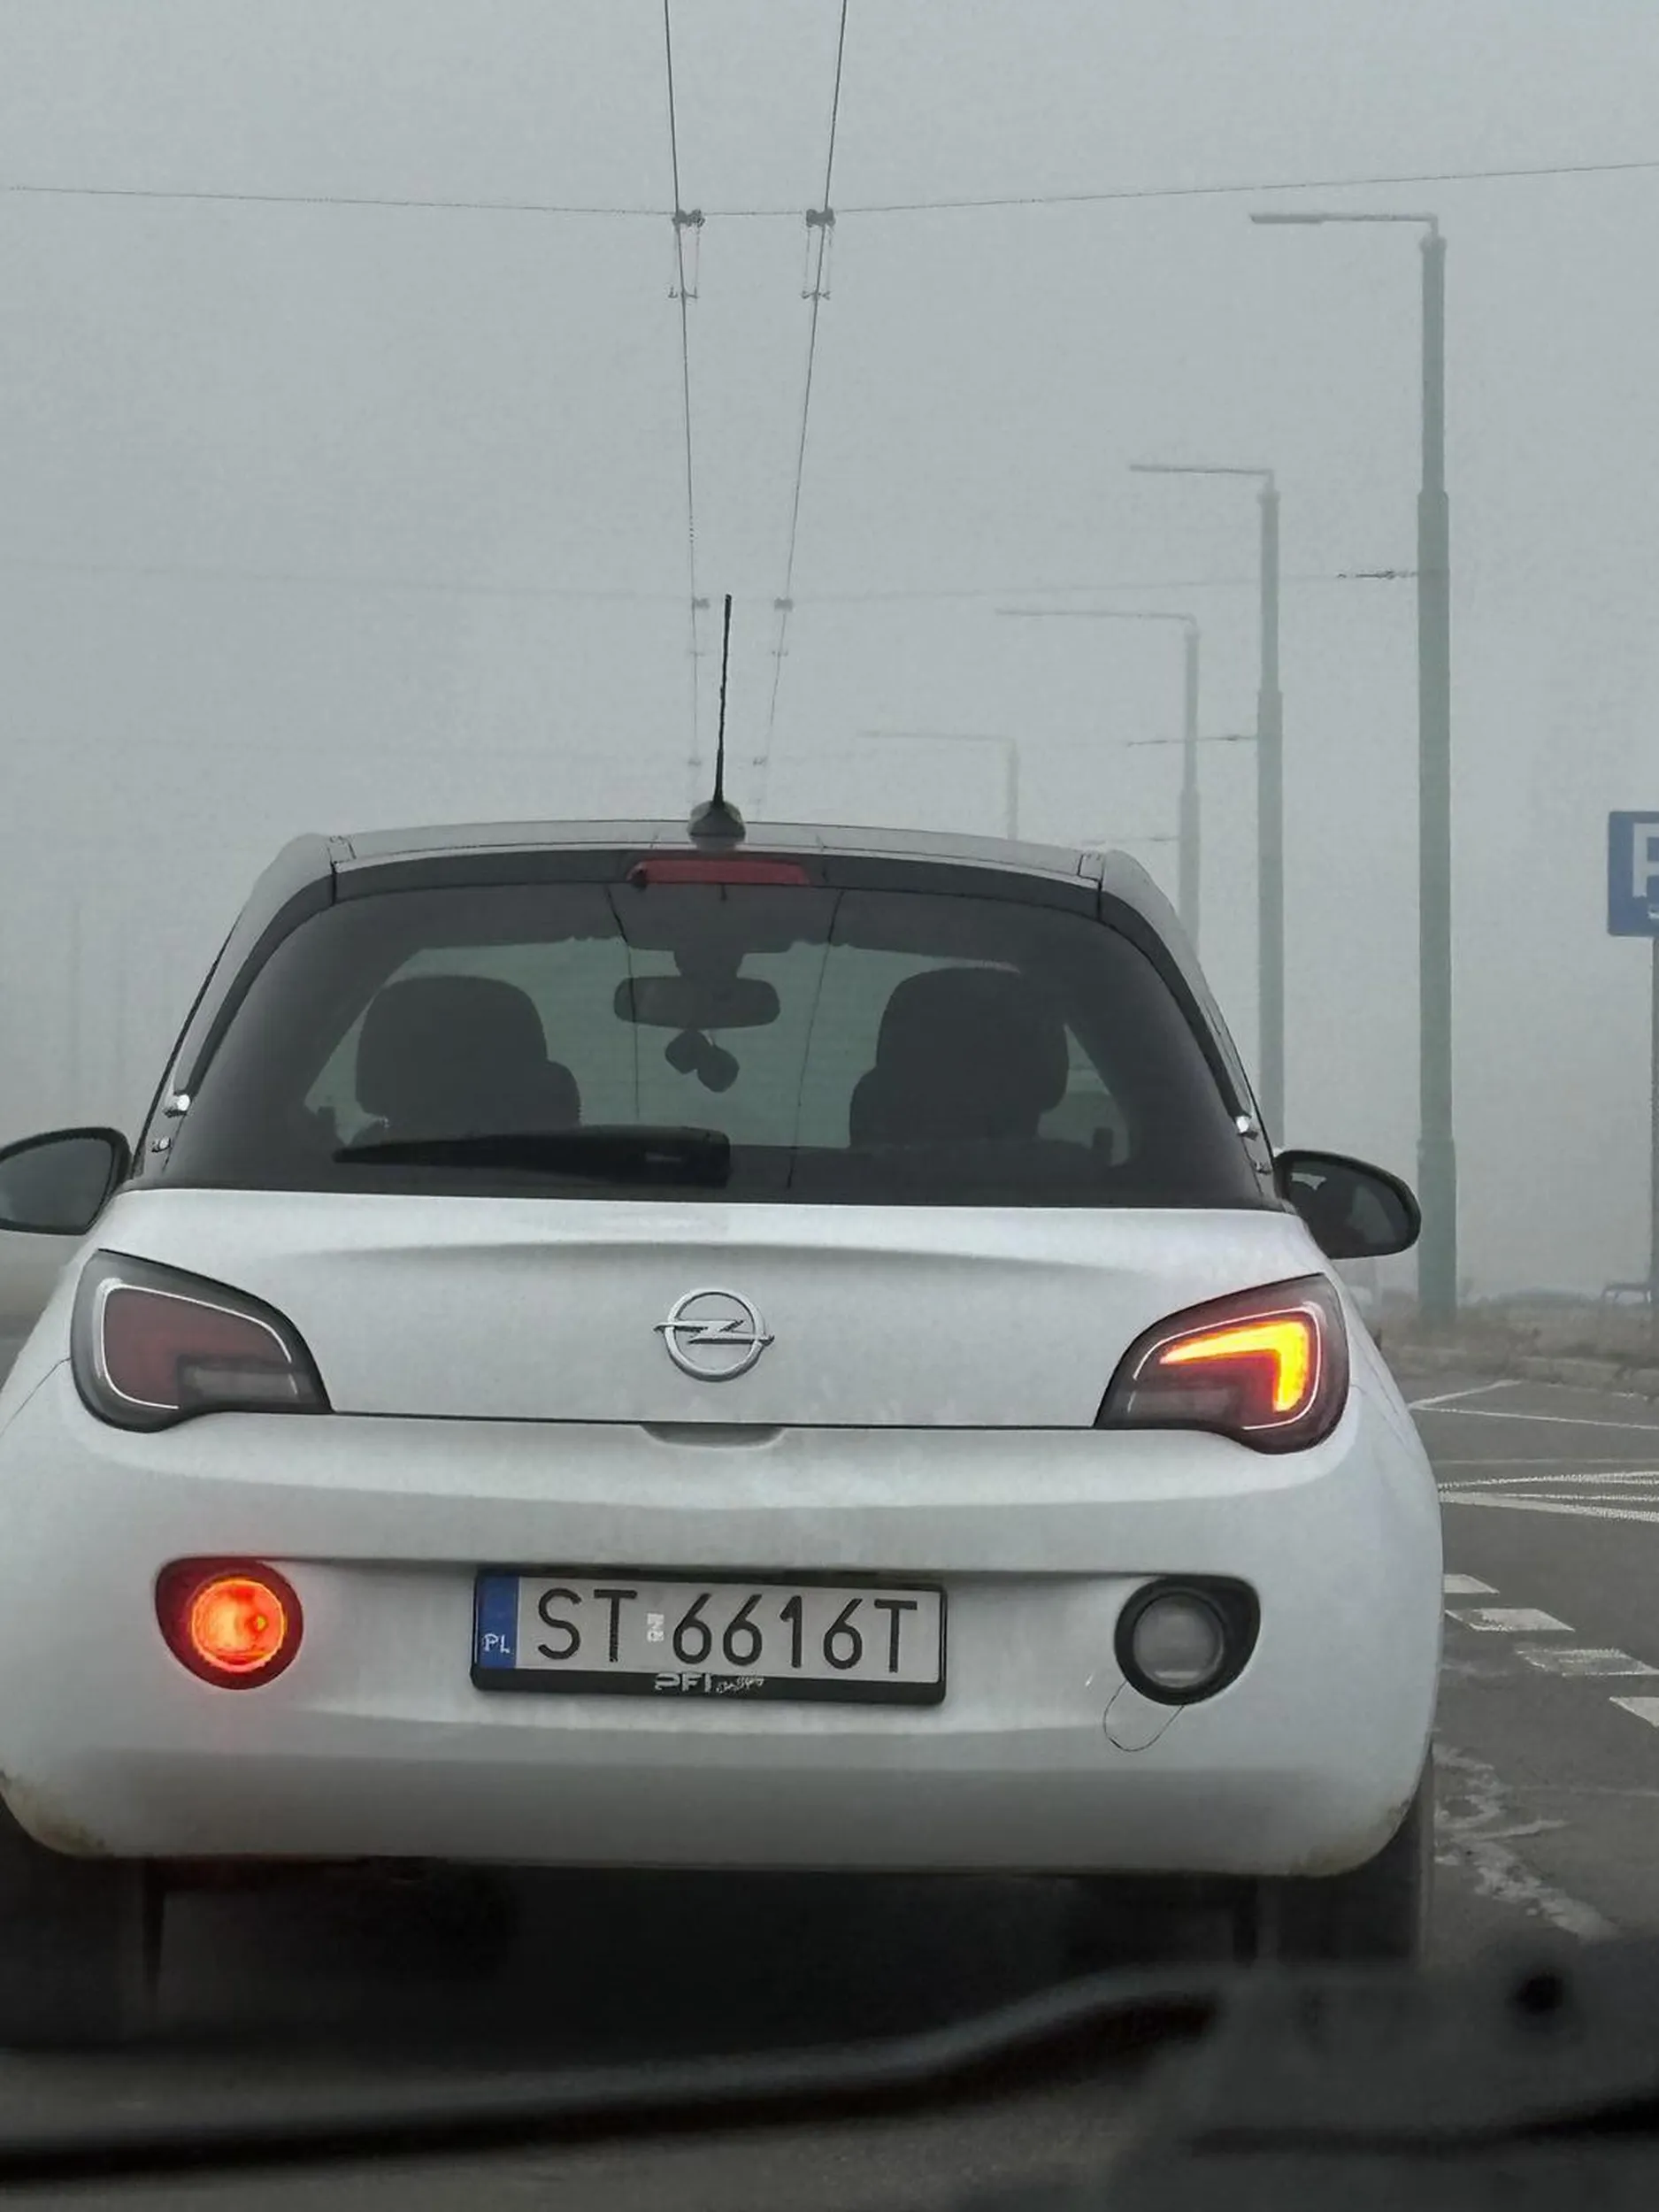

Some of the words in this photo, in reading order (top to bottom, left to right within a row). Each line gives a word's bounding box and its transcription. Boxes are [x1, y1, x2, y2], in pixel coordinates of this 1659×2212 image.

[484, 1632, 511, 1654] PL
[537, 1587, 638, 1663] ST
[672, 1594, 918, 1674] 6616T
